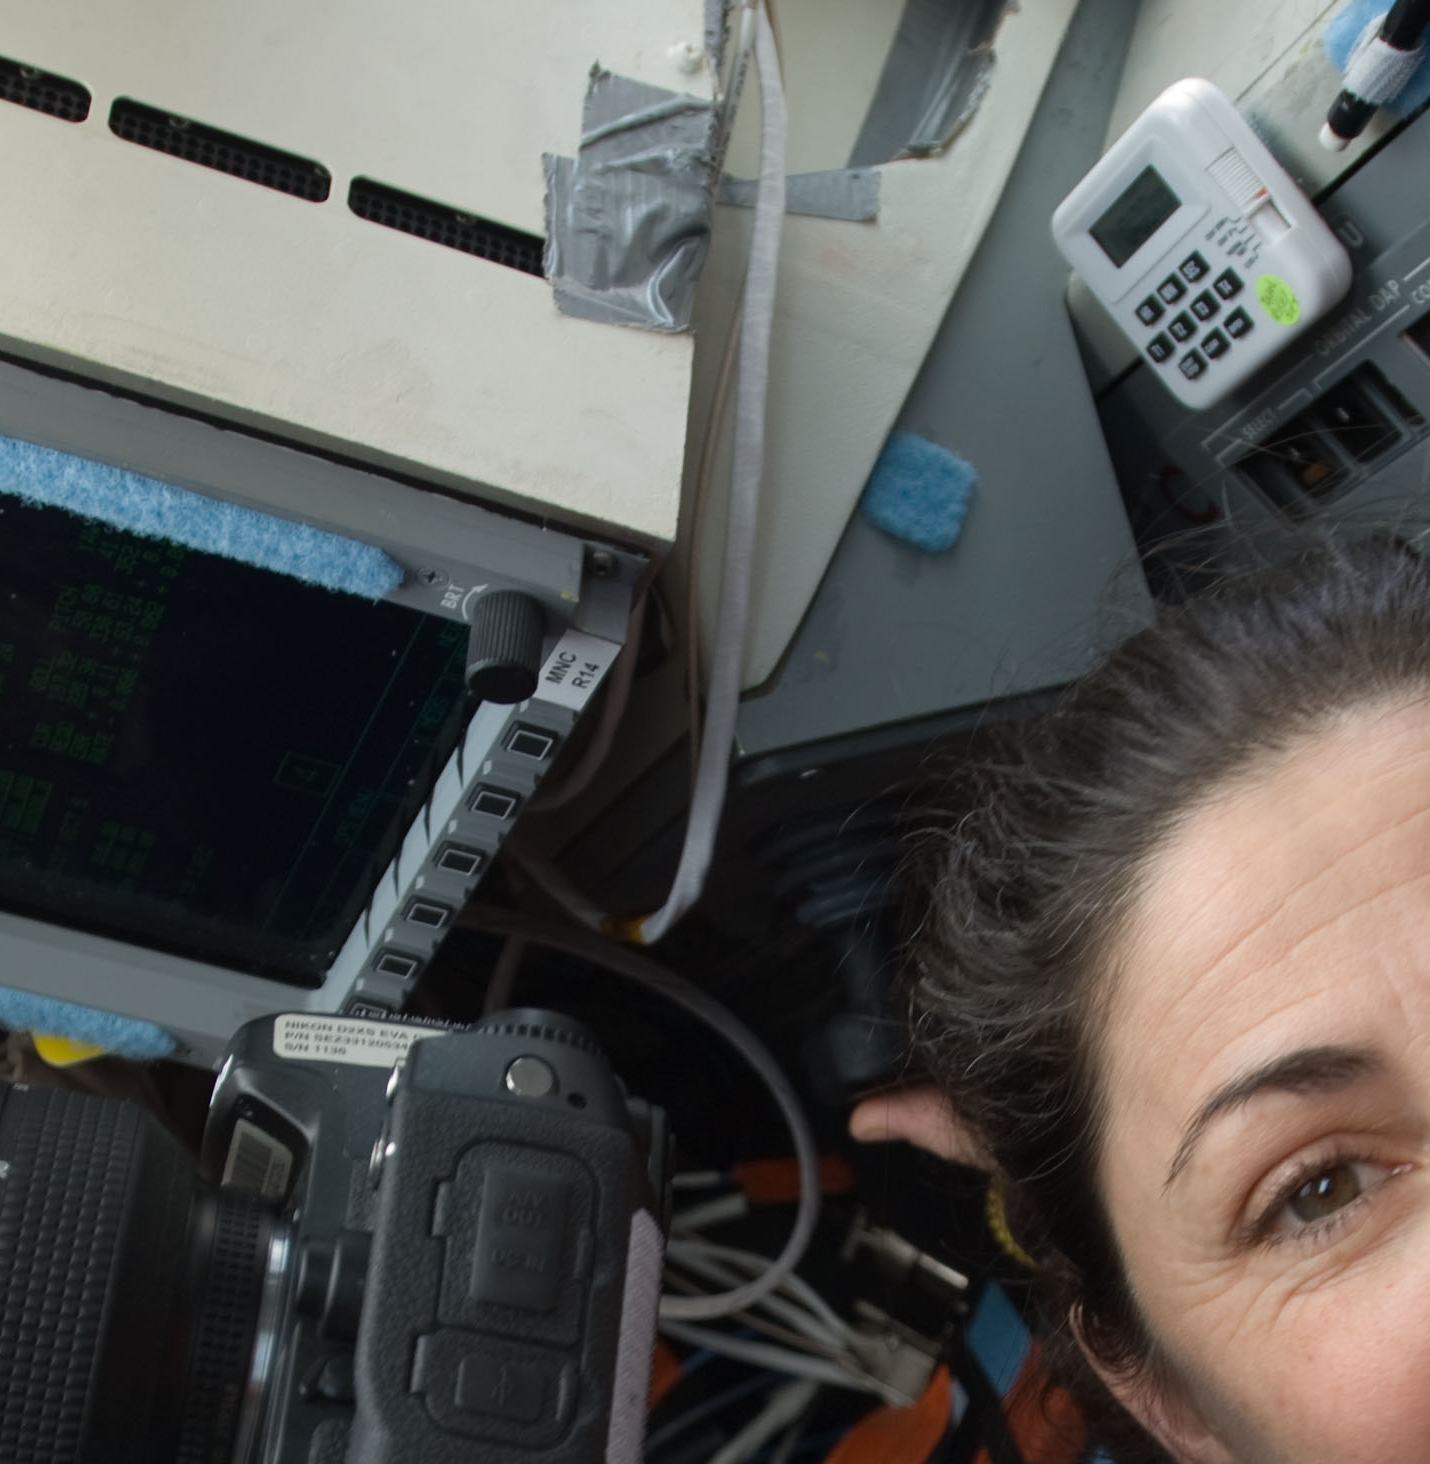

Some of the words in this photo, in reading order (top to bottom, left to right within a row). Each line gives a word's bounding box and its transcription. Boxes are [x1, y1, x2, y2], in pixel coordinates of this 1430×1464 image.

[1368, 280, 1402, 312] DAP
[440, 583, 465, 609] BRT
[545, 651, 577, 685] MNC
[572, 662, 600, 689] R14
[284, 1020, 333, 1034] NIKON
